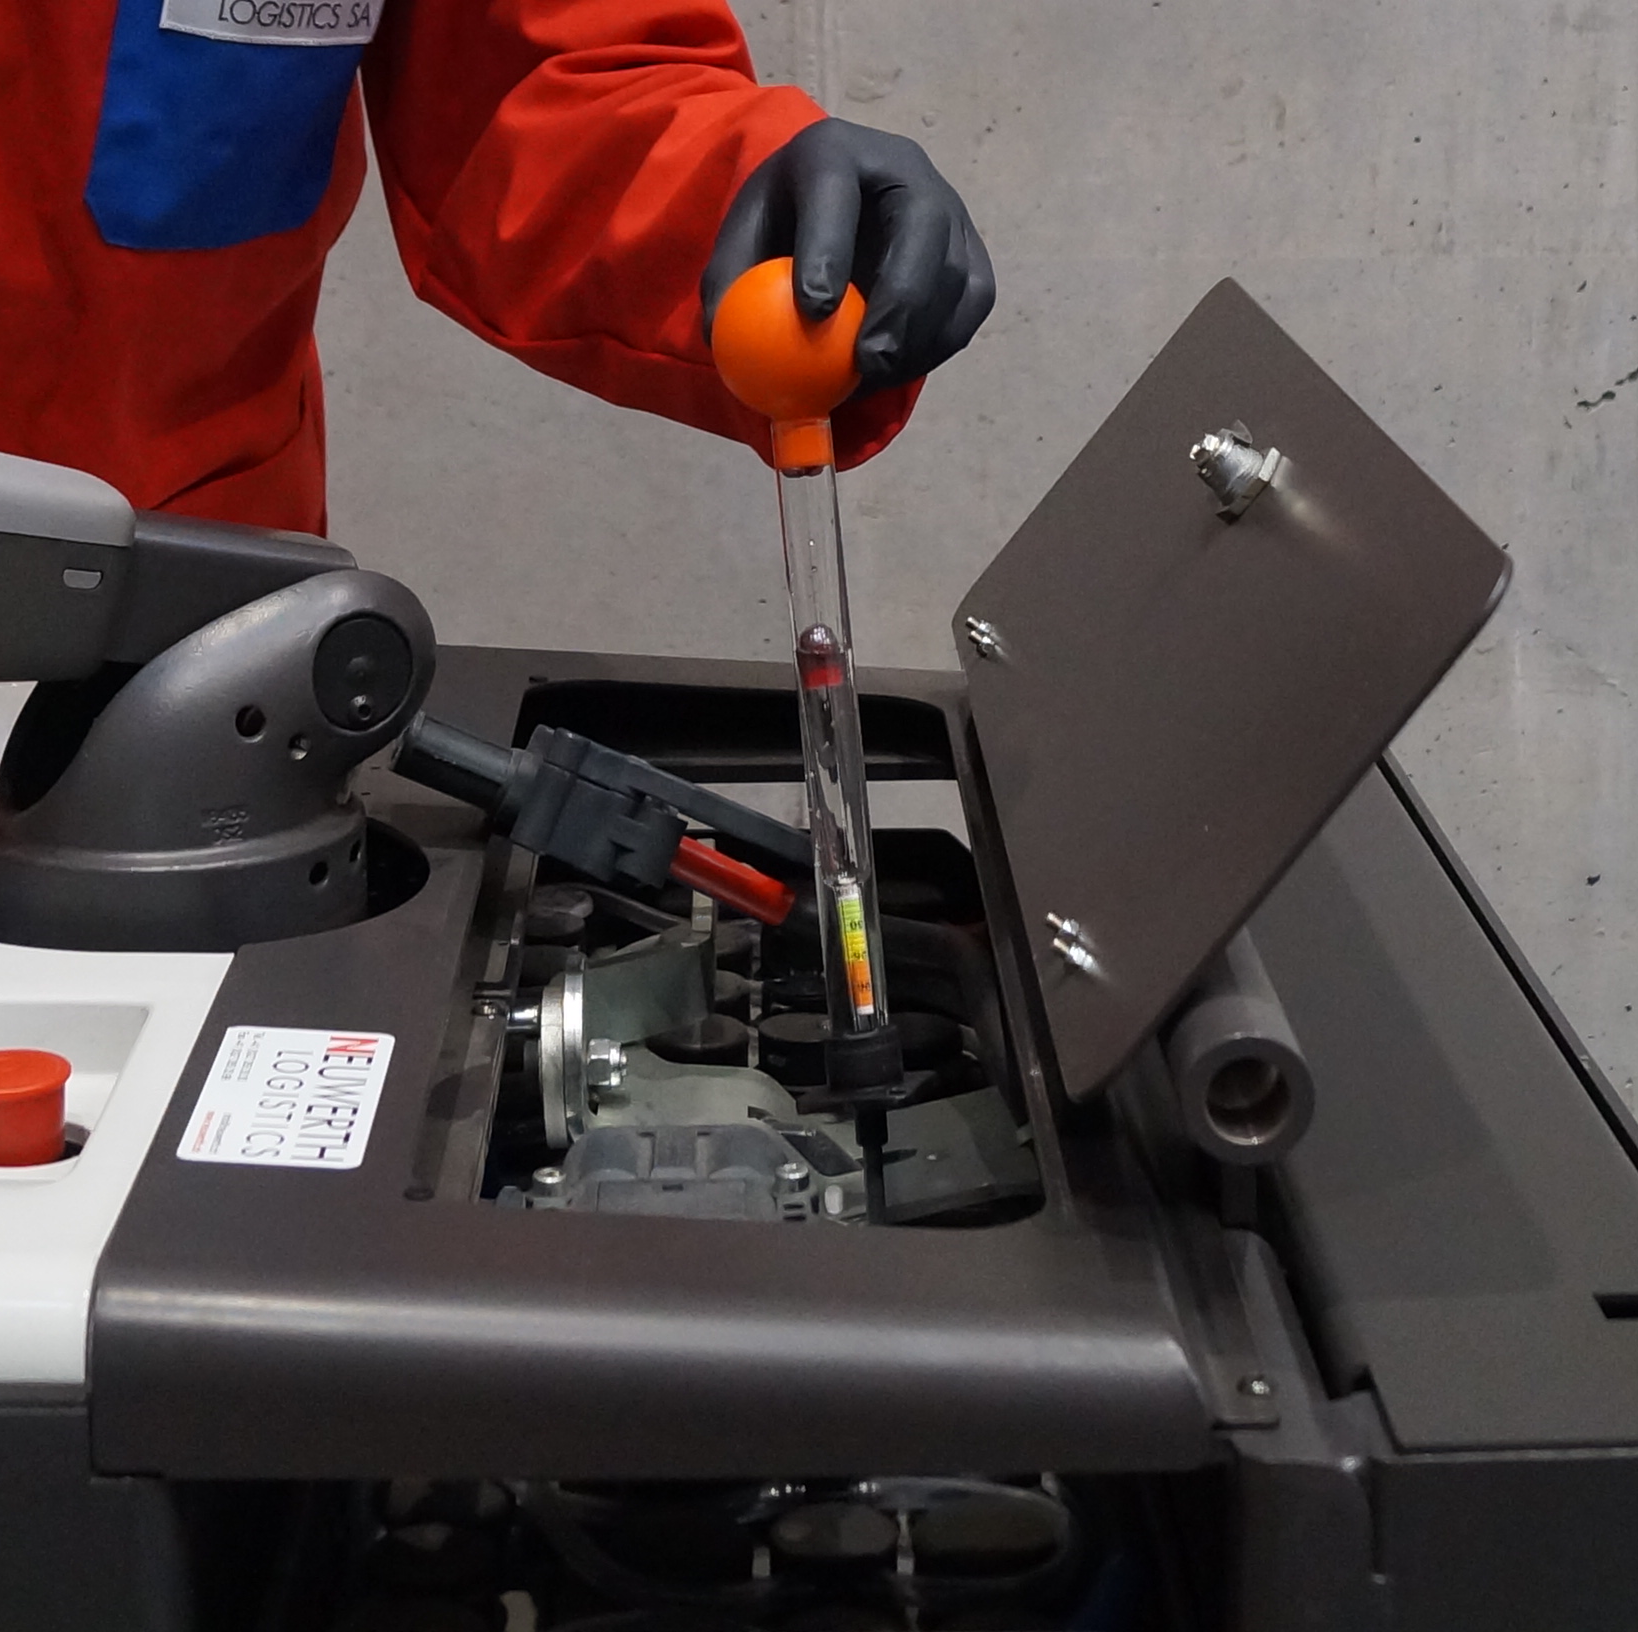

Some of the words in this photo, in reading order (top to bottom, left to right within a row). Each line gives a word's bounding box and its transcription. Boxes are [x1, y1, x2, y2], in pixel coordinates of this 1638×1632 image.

[346, 2, 372, 29] SA
[240, 1050, 314, 1158] LOGISTICS
[290, 1035, 379, 1162] NEUWERTH
